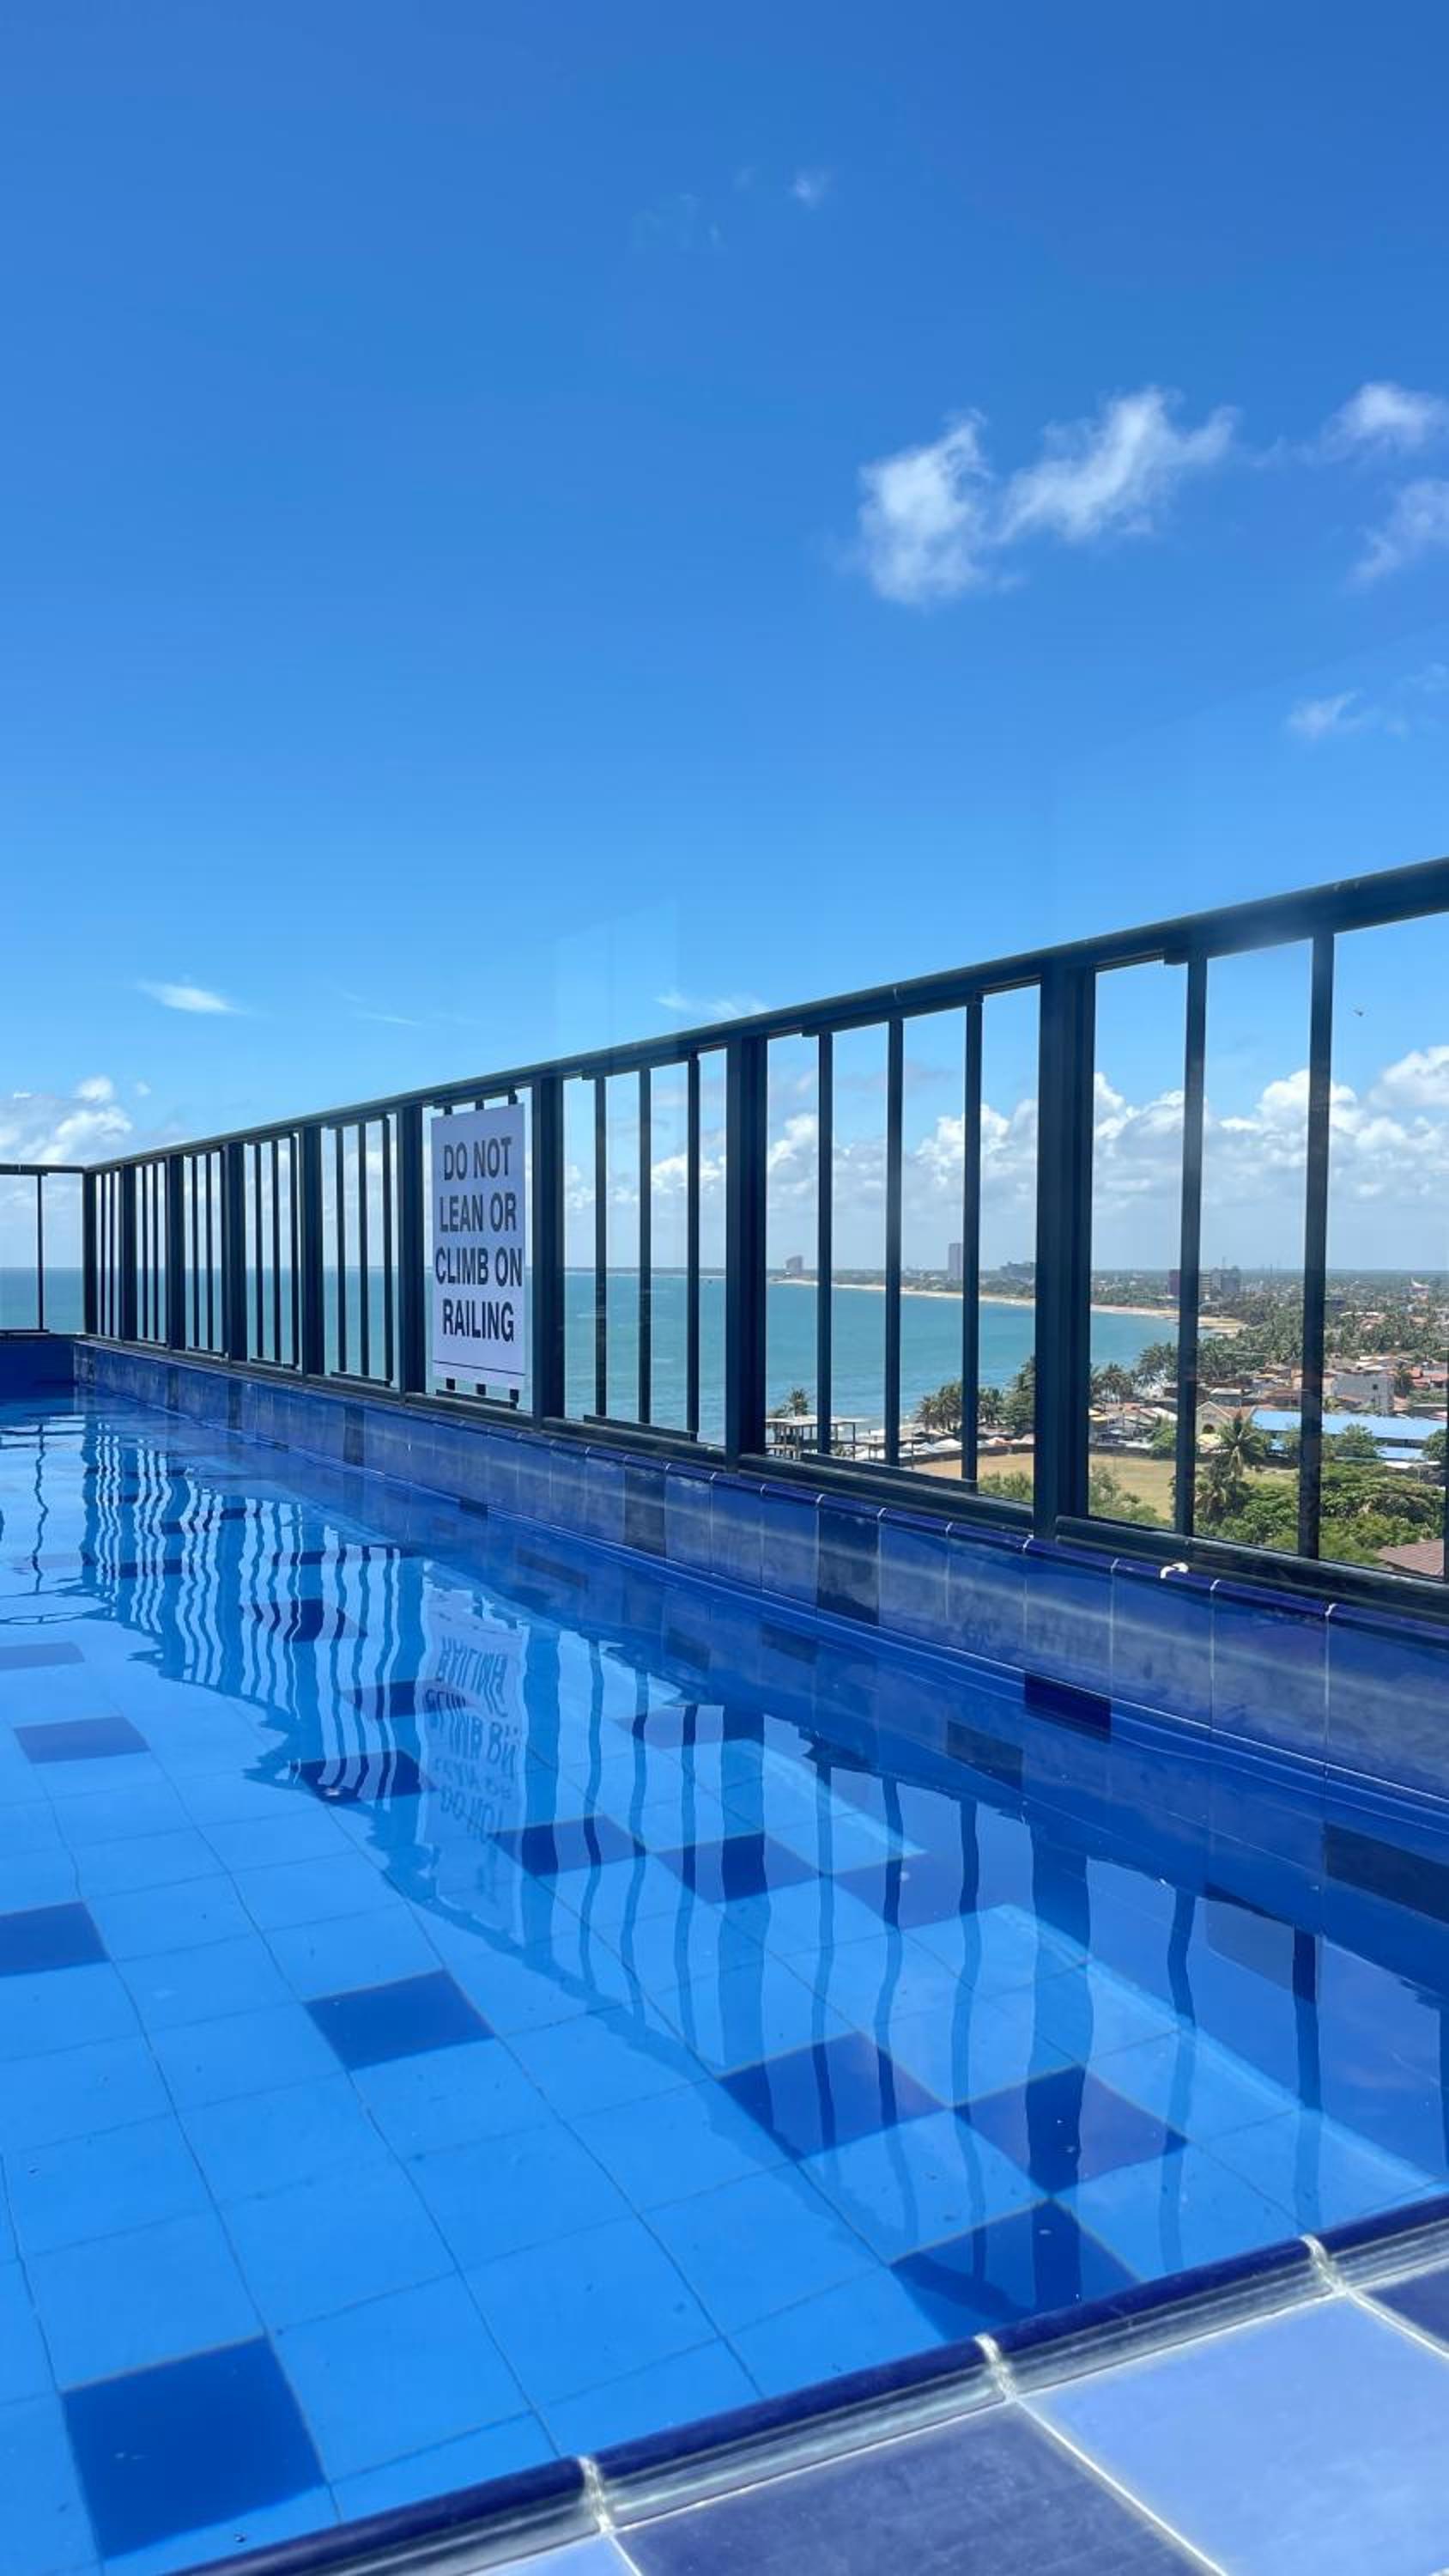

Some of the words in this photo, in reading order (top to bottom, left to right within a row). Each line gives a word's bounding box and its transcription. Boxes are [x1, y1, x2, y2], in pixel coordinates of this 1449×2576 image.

[444, 1143, 468, 1181] DO
[474, 1137, 512, 1178] NOT
[440, 1194, 483, 1232] LEAN
[490, 1192, 517, 1231] OR
[435, 1248, 488, 1285] CLIMB
[495, 1248, 522, 1287] ON
[443, 1298, 514, 1341] RAILING
